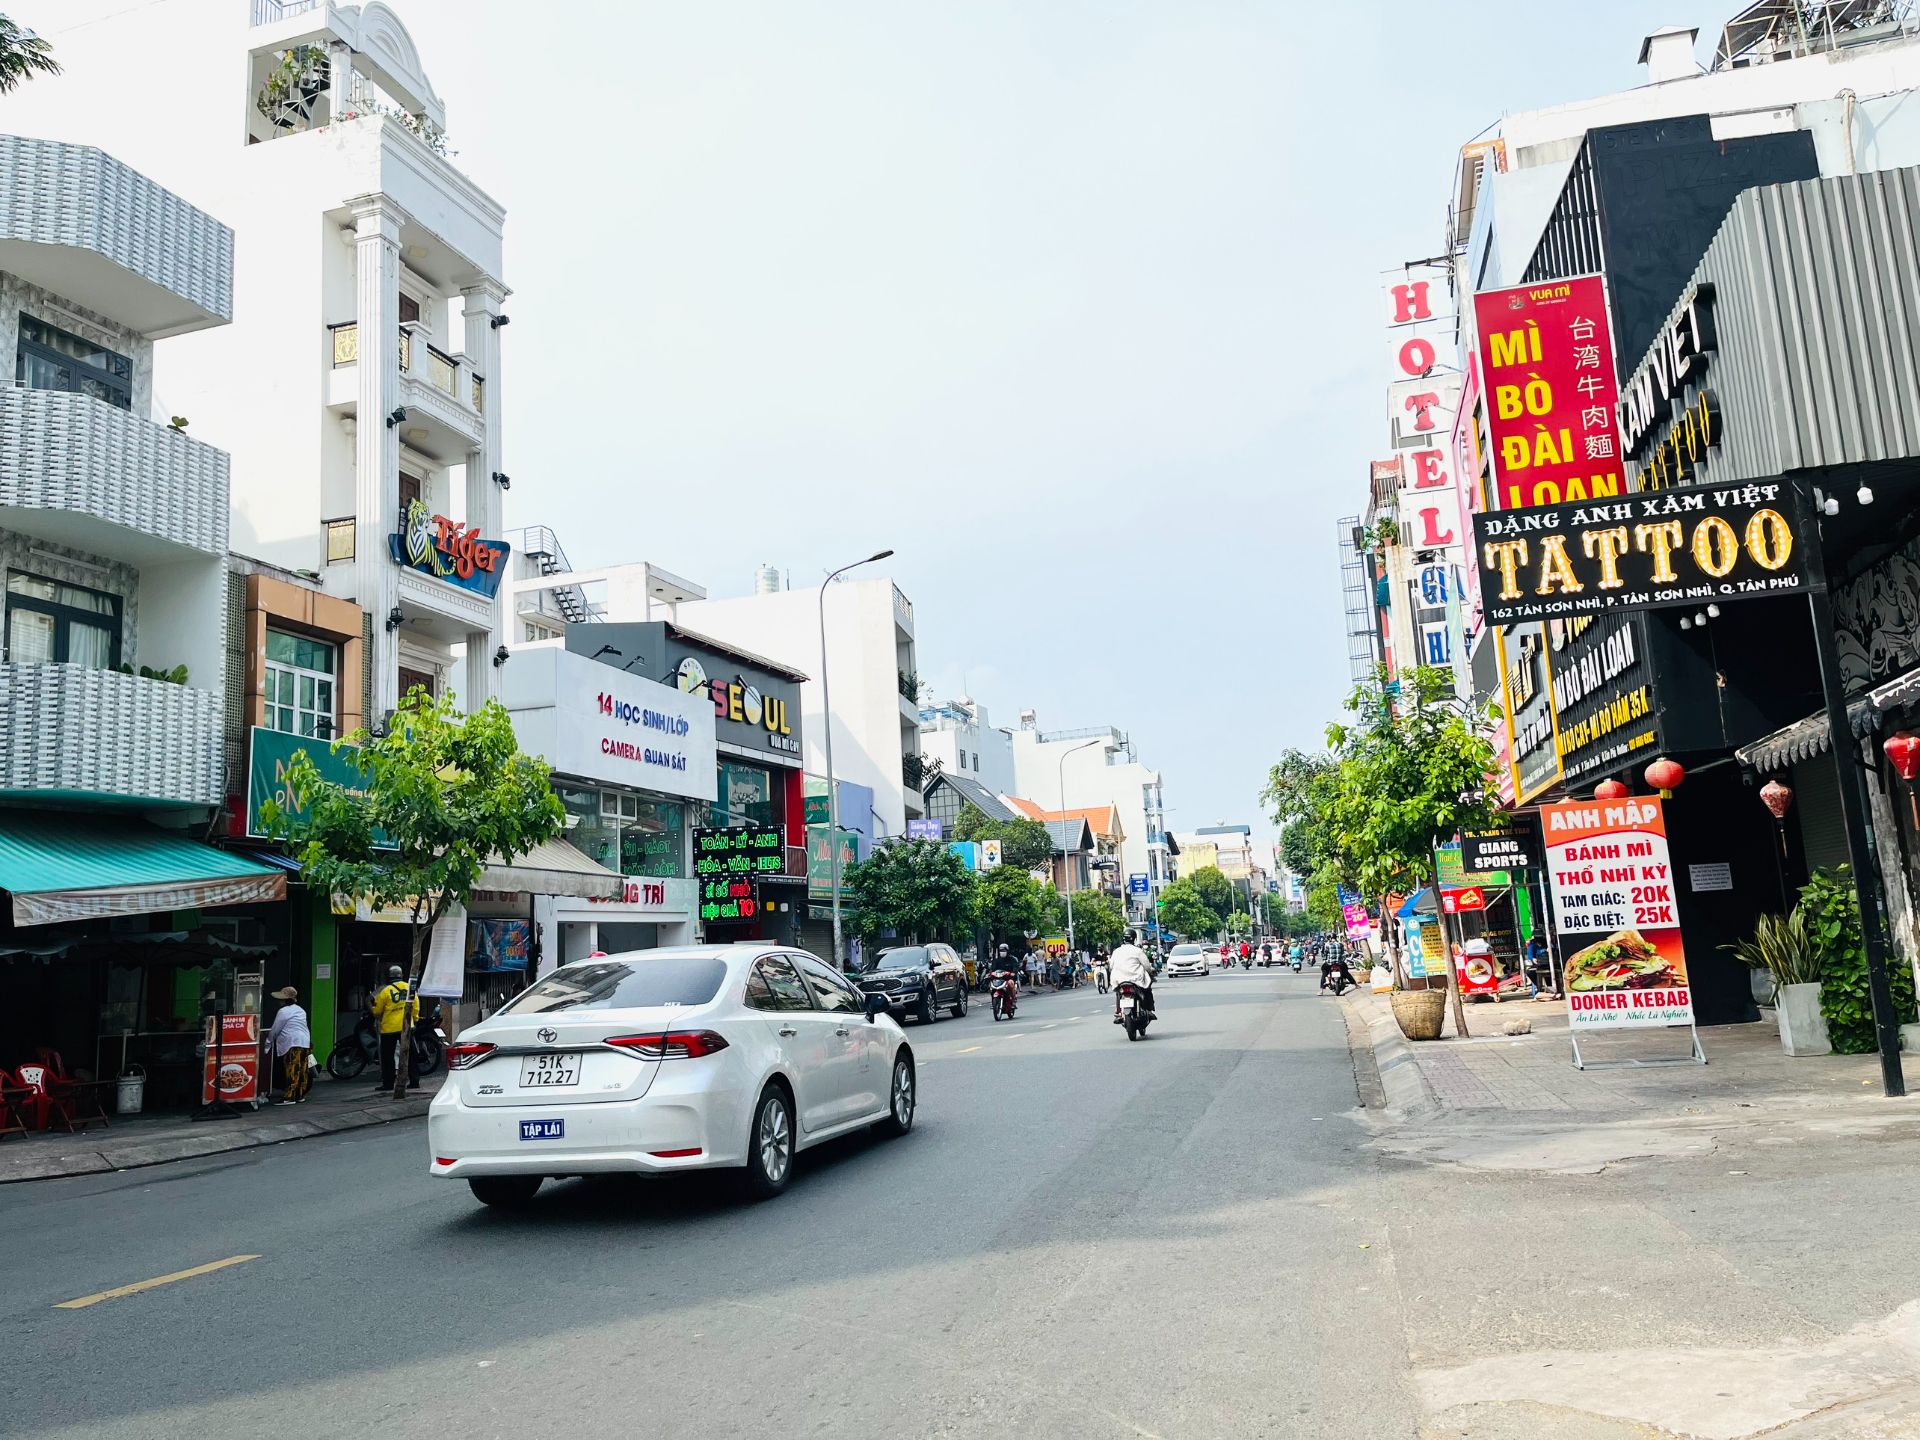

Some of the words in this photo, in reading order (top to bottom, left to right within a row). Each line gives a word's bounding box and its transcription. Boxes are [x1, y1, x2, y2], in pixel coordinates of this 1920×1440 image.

[1529, 288, 1553, 301] VUA
[1489, 319, 1543, 368] MÌ
[1496, 372, 1553, 420] BÒ
[1568, 315, 1614, 460] 台湾牛肉麵
[1391, 281, 1453, 546] HOTEL
[1501, 424, 1574, 471] ĐÀI
[1637, 391, 1710, 492] TATTOO
[1571, 503, 1633, 526] ANH
[1641, 495, 1705, 516] XĂM
[1713, 484, 1779, 508] VIỆT
[431, 514, 501, 579] Tiger
[1484, 508, 1793, 600] TATTOO
[1491, 608, 1513, 619] 162
[1515, 603, 1542, 618] TÂN
[1546, 601, 1572, 613] SƠN
[1576, 596, 1604, 610] NHÌ,
[1607, 597, 1618, 607] P.
[1621, 592, 1649, 605] TÂN
[1654, 588, 1683, 601] SƠN
[1686, 583, 1716, 598] NHÌ,
[1720, 584, 1735, 595] Q.
[1737, 578, 1767, 592] TÂN
[1770, 573, 1799, 589] PHÚ
[1553, 667, 1567, 714] MÌ
[1565, 656, 1581, 706] BÒ
[1580, 645, 1602, 695] ĐÀI
[1601, 621, 1635, 681] LOAN
[597, 692, 613, 716] 14
[615, 700, 640, 726] HỌC
[1590, 707, 1600, 740] MÌ
[1599, 701, 1611, 735] BÒ
[601, 738, 642, 761] CAMERA
[645, 748, 670, 767] QUAN
[672, 752, 686, 771] SÁT
[1551, 809, 1600, 831] ANH
[1605, 800, 1657, 829] MẬP
[701, 833, 728, 850] TOÁN
[736, 831, 748, 848] LÝ
[755, 834, 777, 847] ANH
[1479, 841, 1519, 854] GIANG
[1565, 844, 1620, 861] BÁNH
[1627, 840, 1653, 857] MÌ
[698, 855, 721, 873] HÓA
[728, 855, 750, 871] VĂN
[757, 856, 781, 870] IELTS
[1475, 854, 1528, 868] SPORTS
[1556, 865, 1594, 885] THỔ
[1601, 865, 1635, 883] NHĨ
[1642, 862, 1667, 880] KỲ
[643, 881, 664, 904] TRÍ
[1561, 894, 1587, 908] TAM
[1591, 891, 1626, 906] GIÁC:
[1631, 885, 1671, 904] 20K
[739, 899, 755, 917] TO
[1564, 913, 1590, 930] ĐẶC
[1594, 911, 1625, 929] BIỆT:
[1635, 905, 1673, 925] 25K
[1571, 993, 1628, 1011] DONER
[1632, 991, 1689, 1008] KEBAB
[538, 1055, 565, 1069] 51K
[527, 1070, 573, 1085] 712.27
[523, 1123, 542, 1139] TẬP
[544, 1122, 560, 1136] LÁI
